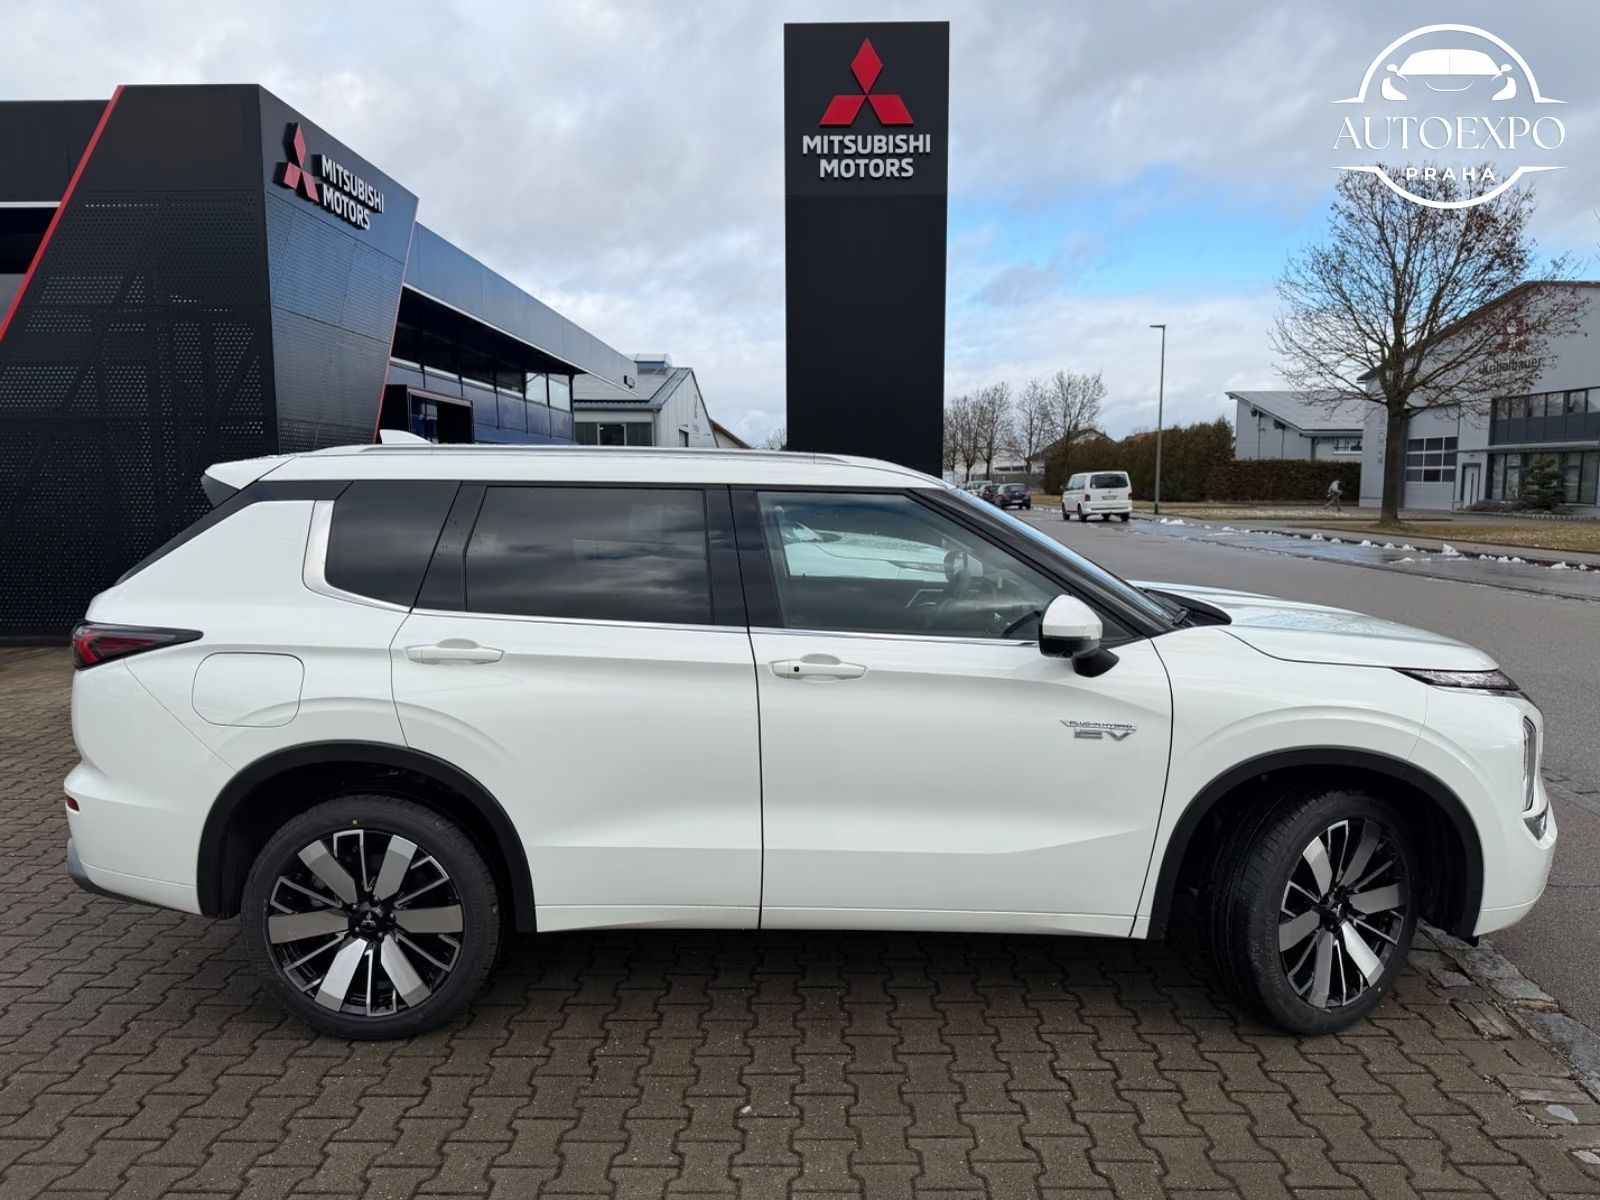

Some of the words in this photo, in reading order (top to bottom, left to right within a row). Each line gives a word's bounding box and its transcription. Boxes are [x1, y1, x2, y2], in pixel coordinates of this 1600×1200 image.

[802, 134, 931, 154] MITSUBISHI
[321, 154, 384, 214] MITSUBISHI
[819, 158, 914, 178] MOTORS
[322, 183, 371, 230] MOTORS
